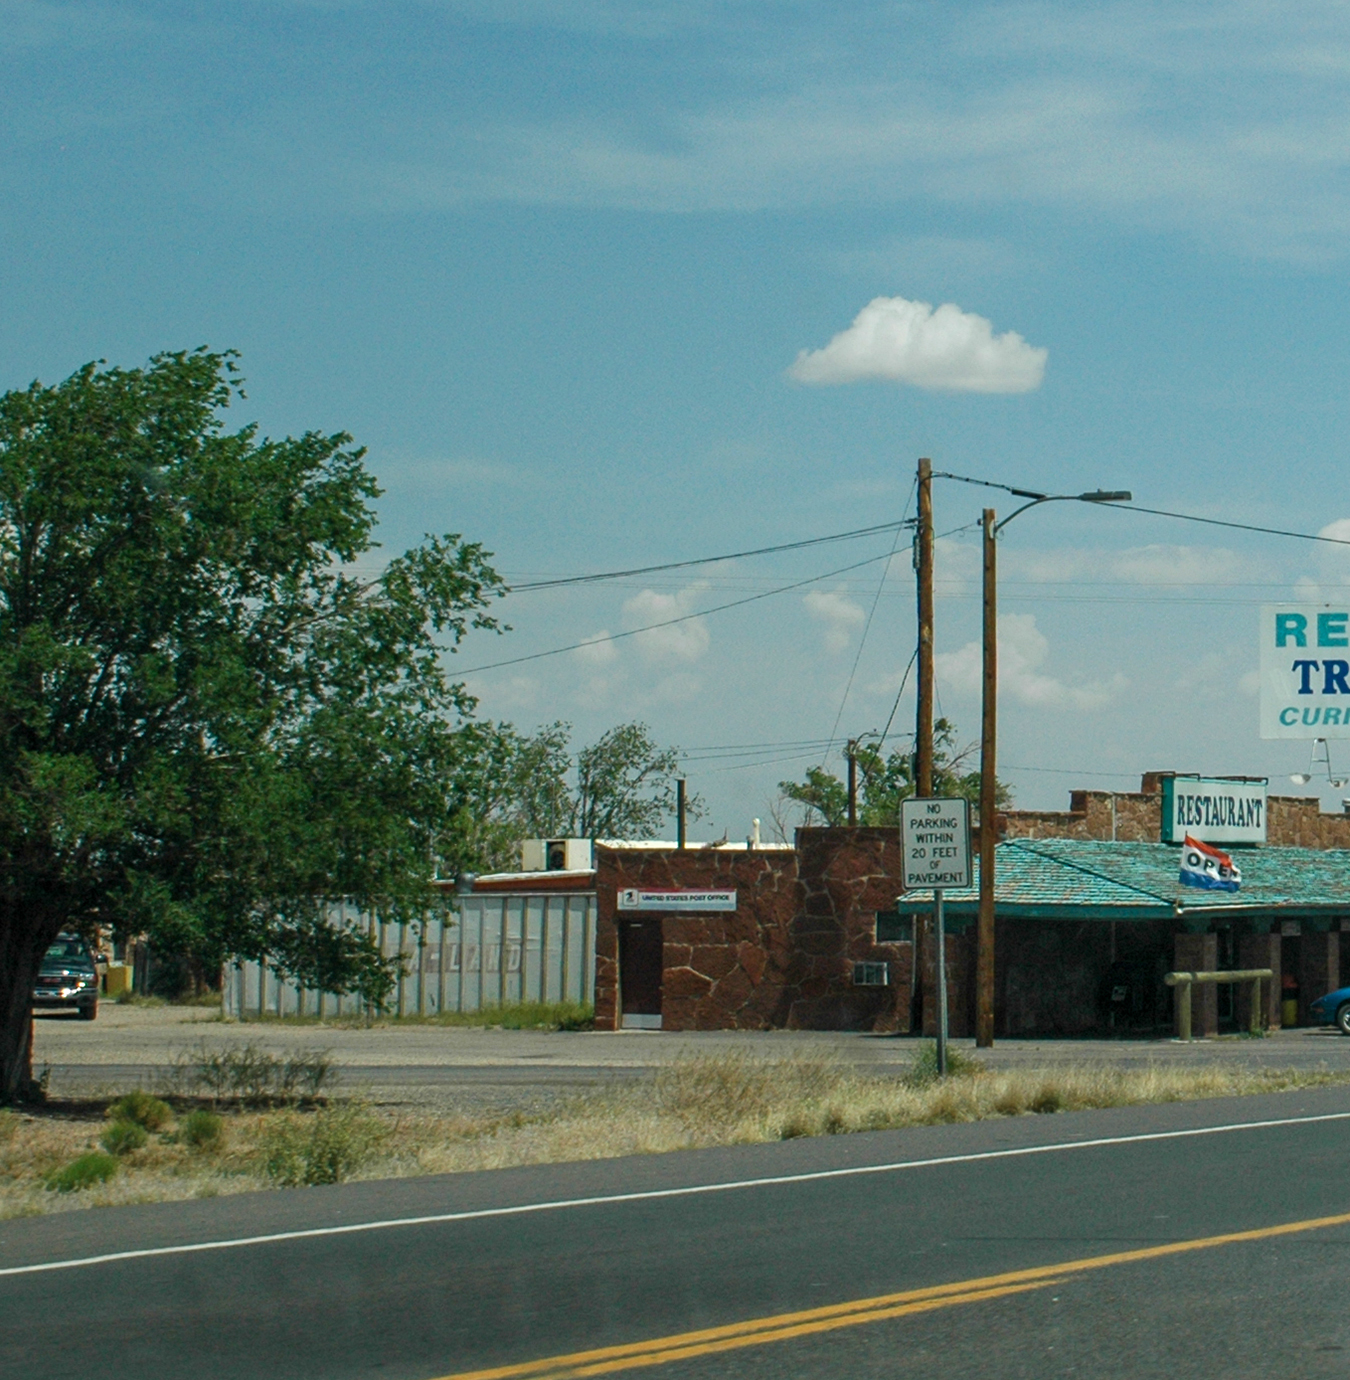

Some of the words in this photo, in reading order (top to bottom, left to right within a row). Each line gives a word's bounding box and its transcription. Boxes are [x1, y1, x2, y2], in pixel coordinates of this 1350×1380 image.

[927, 804, 941, 814] NO
[1177, 794, 1263, 828] RESTAURANT
[910, 818, 958, 828] PARKING
[916, 833, 953, 843] WITHIN
[911, 848, 926, 858] 20
[933, 847, 957, 857] FEET
[930, 860, 941, 869] OF
[909, 872, 963, 883] PAVEMENT
